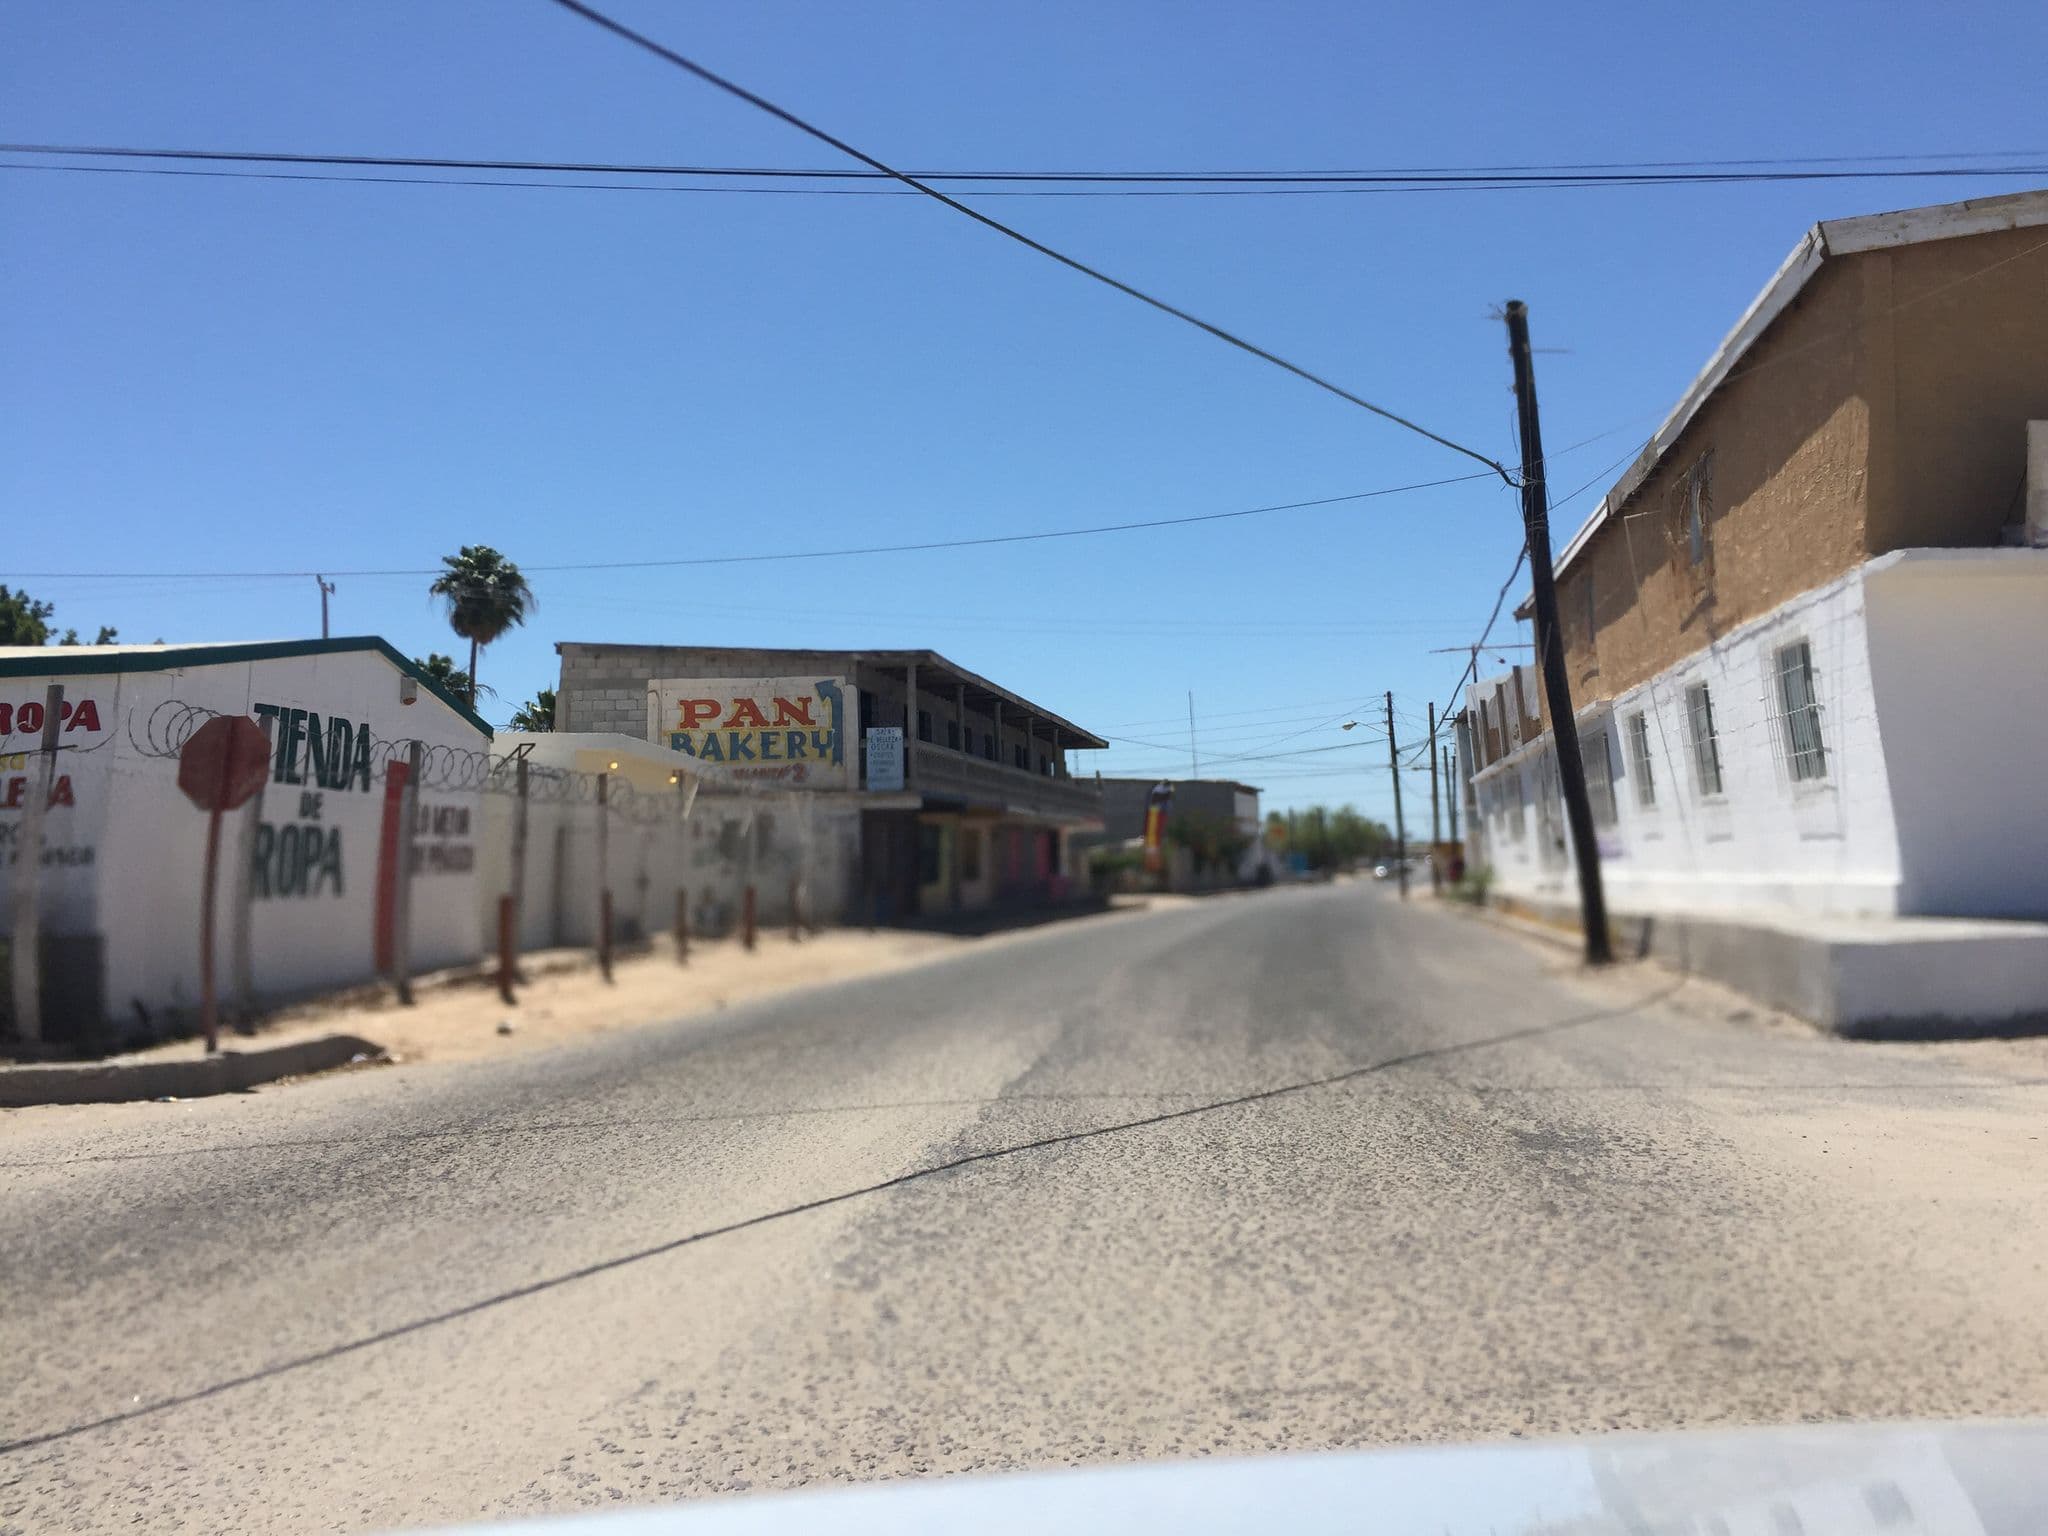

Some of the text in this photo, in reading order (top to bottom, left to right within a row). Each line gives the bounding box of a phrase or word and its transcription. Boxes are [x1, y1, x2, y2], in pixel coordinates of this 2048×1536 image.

[679, 696, 816, 729] PAN
[670, 730, 835, 762] BAKERY
[301, 791, 324, 821] DE
[253, 823, 344, 899] ROPA
